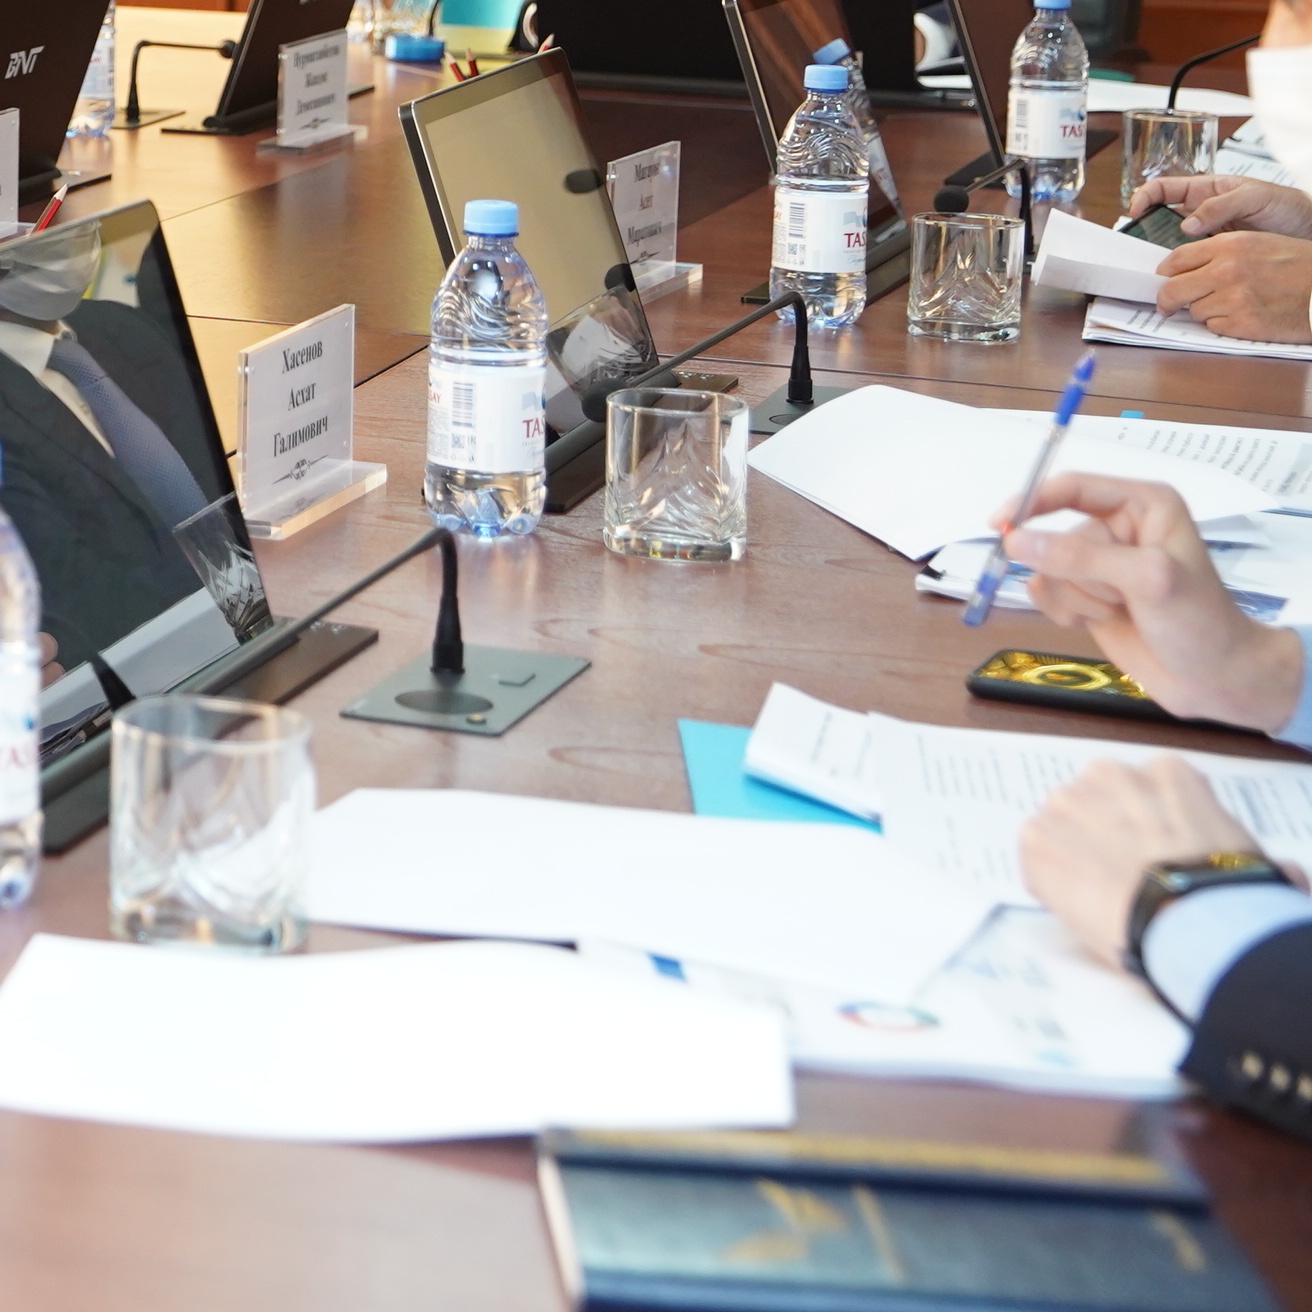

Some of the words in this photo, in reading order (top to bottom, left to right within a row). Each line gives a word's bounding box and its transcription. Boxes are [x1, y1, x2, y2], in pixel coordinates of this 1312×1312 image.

[281, 340, 323, 374] Хасенов
[287, 382, 317, 411] Асхат
[273, 415, 329, 458] Галимович
